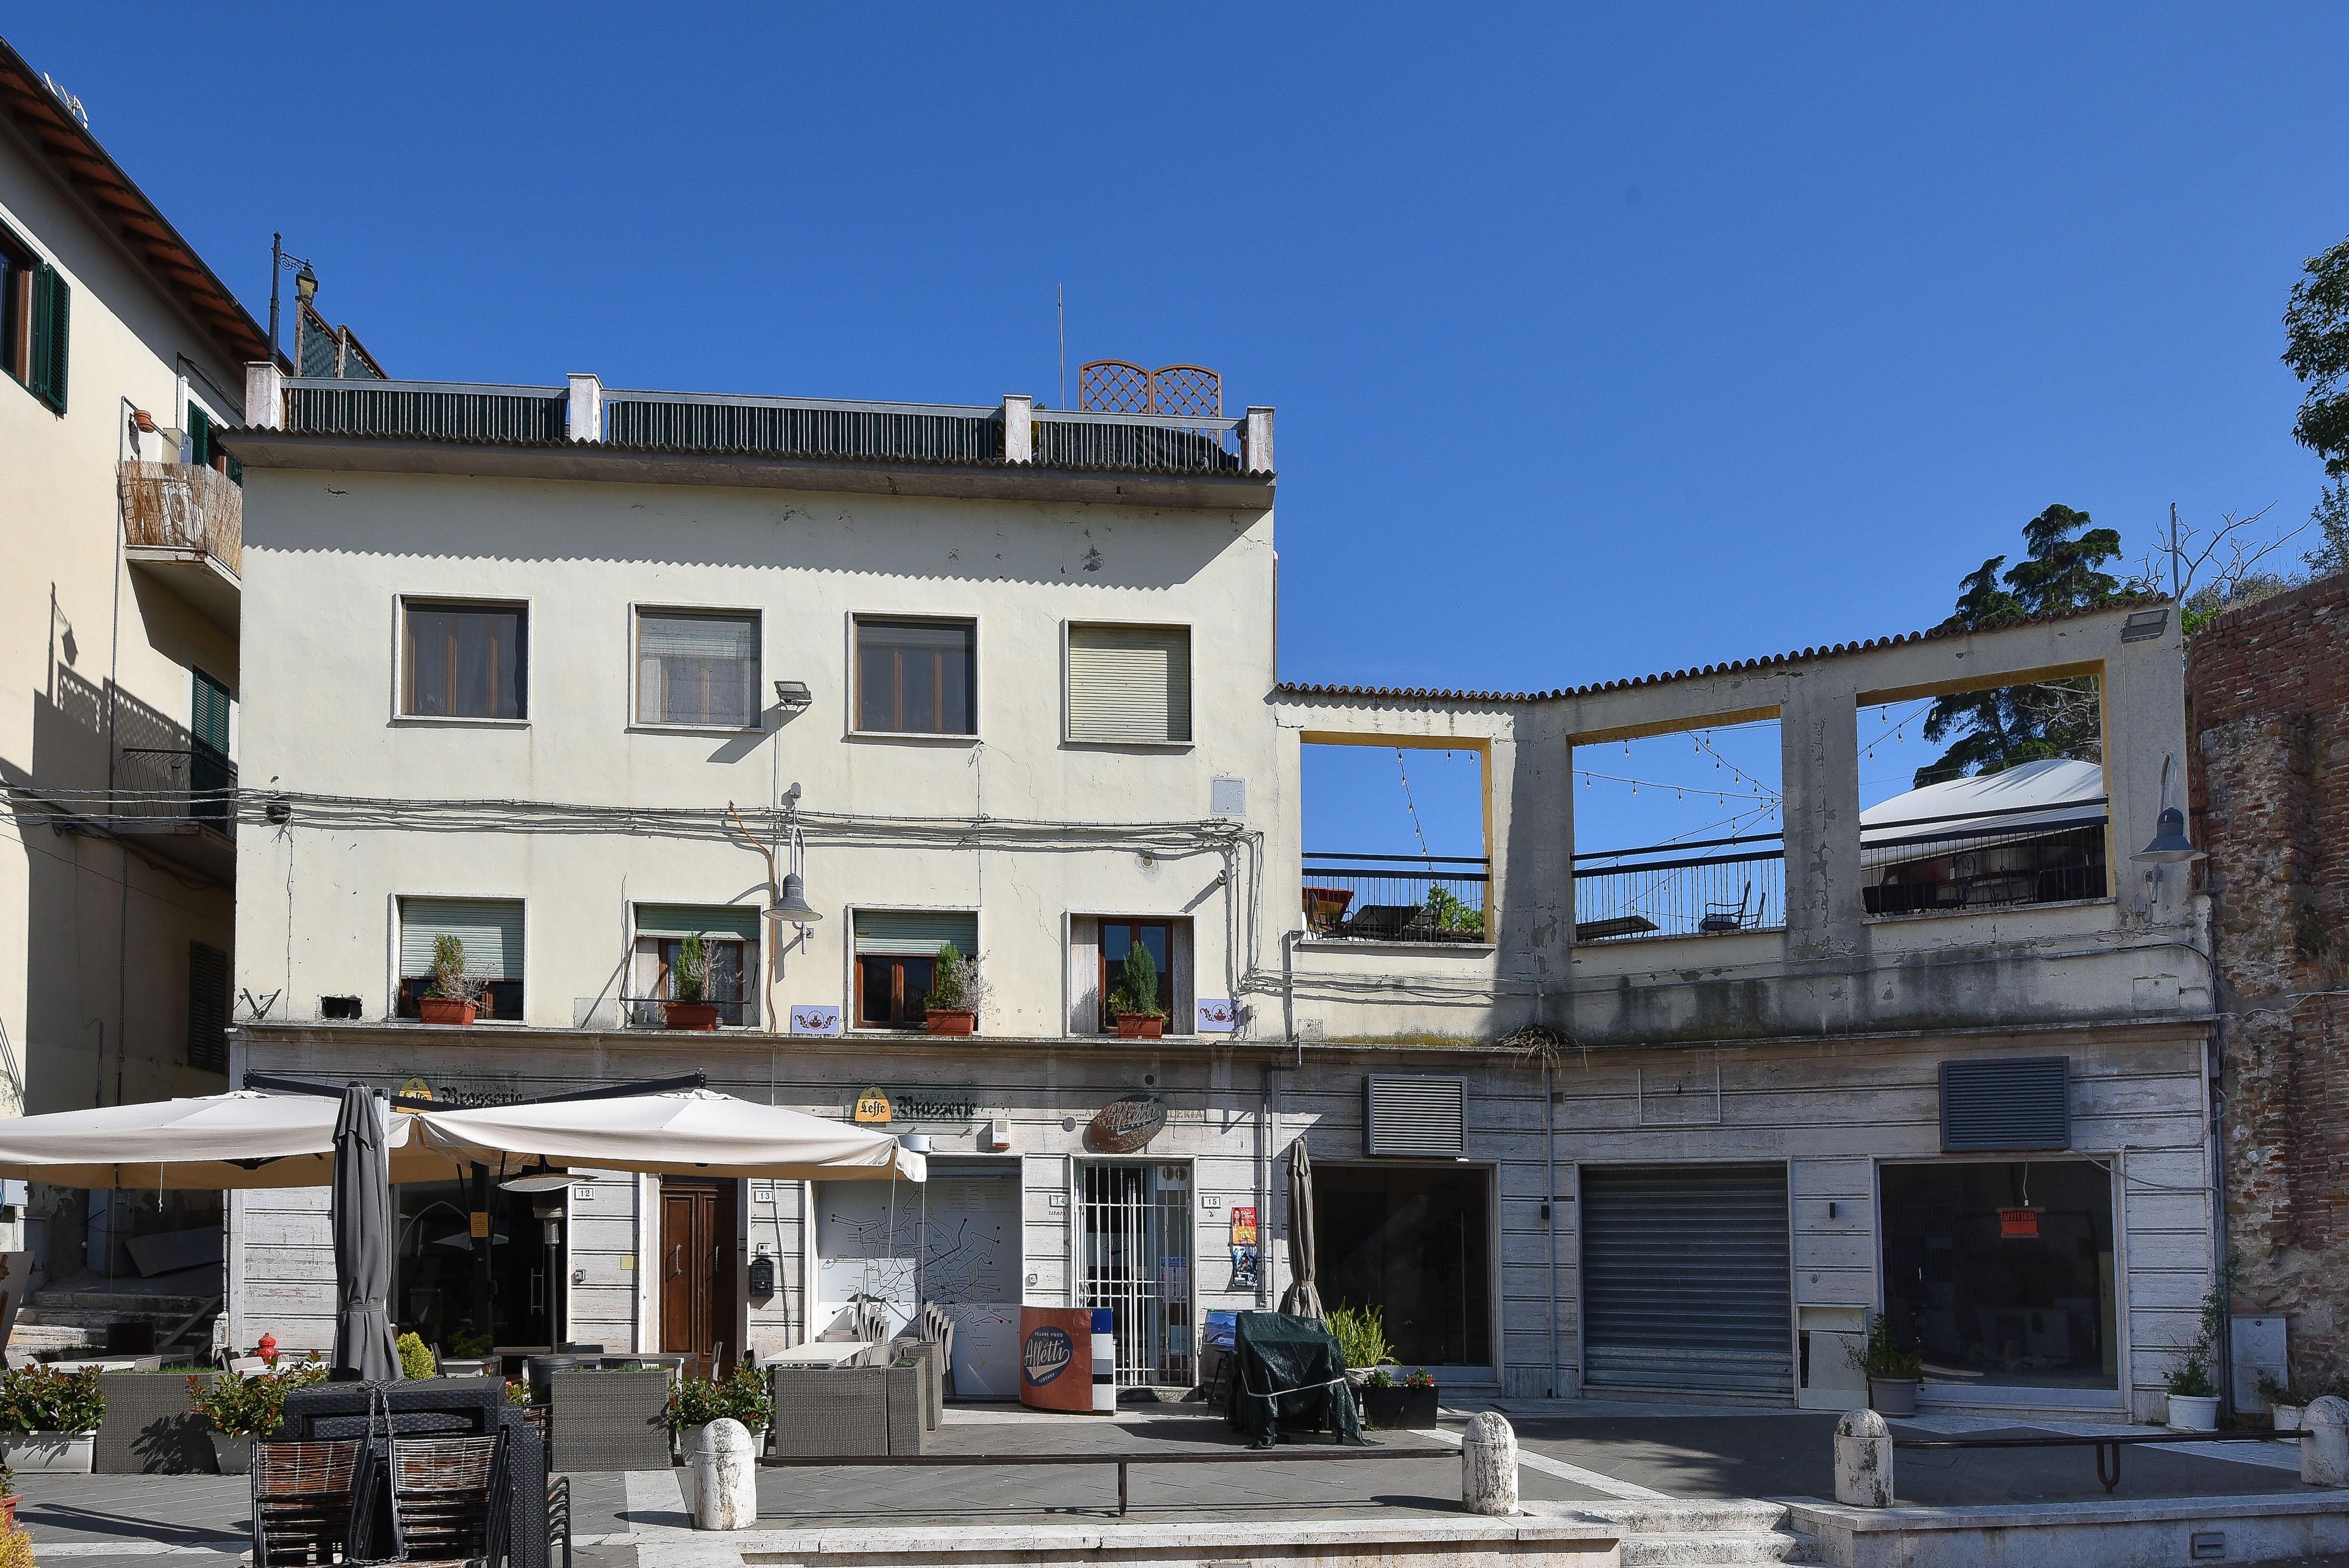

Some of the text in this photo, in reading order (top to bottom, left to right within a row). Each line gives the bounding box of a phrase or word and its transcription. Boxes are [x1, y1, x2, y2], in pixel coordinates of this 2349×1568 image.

[859, 1101, 887, 1117] Leffe
[895, 1095, 978, 1116] Brasserie
[2003, 1211, 2035, 1221] AFFITTASI
[1024, 1339, 1070, 1374] Affetti
[1039, 1372, 1055, 1384] TUSCANY
